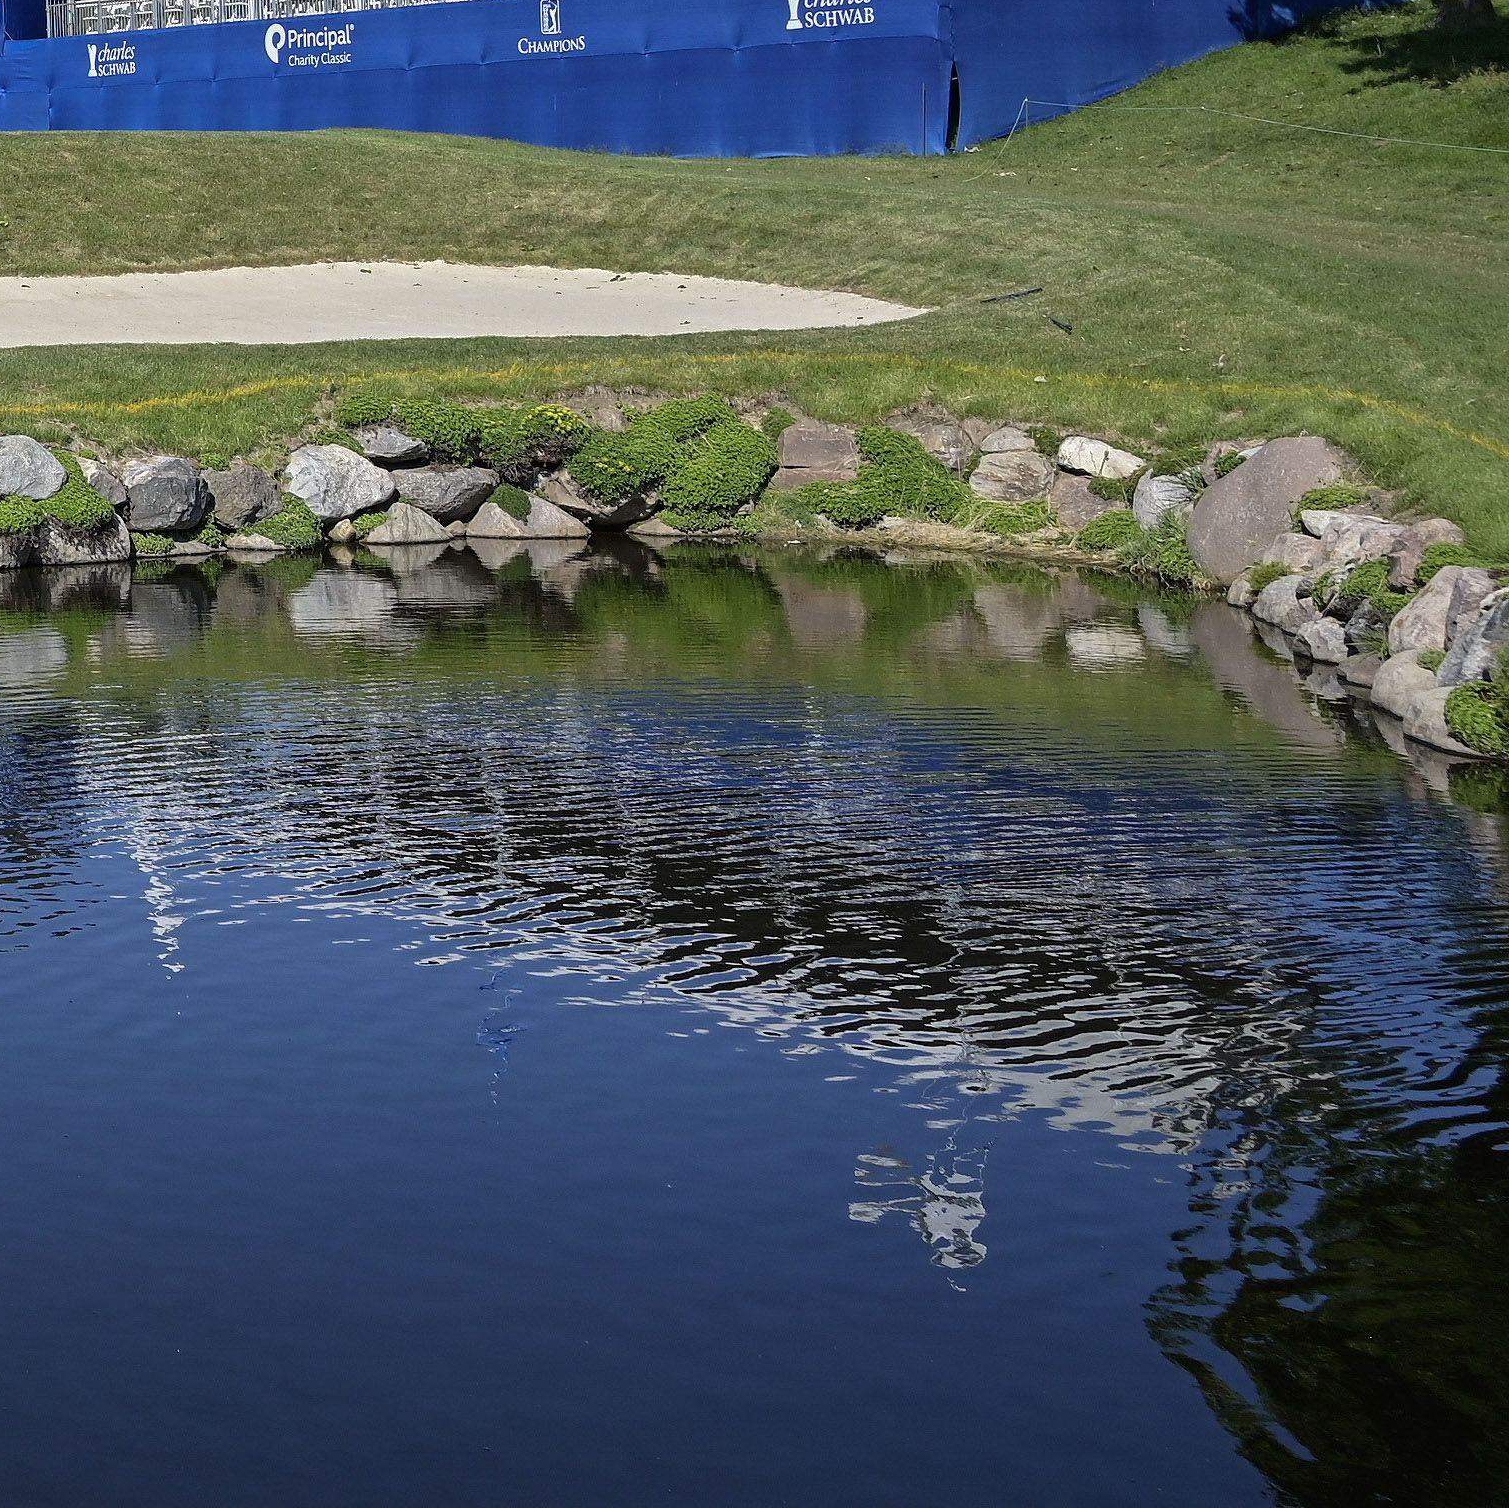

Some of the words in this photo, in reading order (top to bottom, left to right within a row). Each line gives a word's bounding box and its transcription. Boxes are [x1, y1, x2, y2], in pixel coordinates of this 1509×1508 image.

[804, 7, 875, 28] SCHWAB
[97, 40, 136, 63] charles
[517, 32, 586, 54] CHAMPIONS
[97, 59, 137, 77] SCHWAB
[288, 53, 320, 68] Charity
[320, 48, 352, 65] Classic
